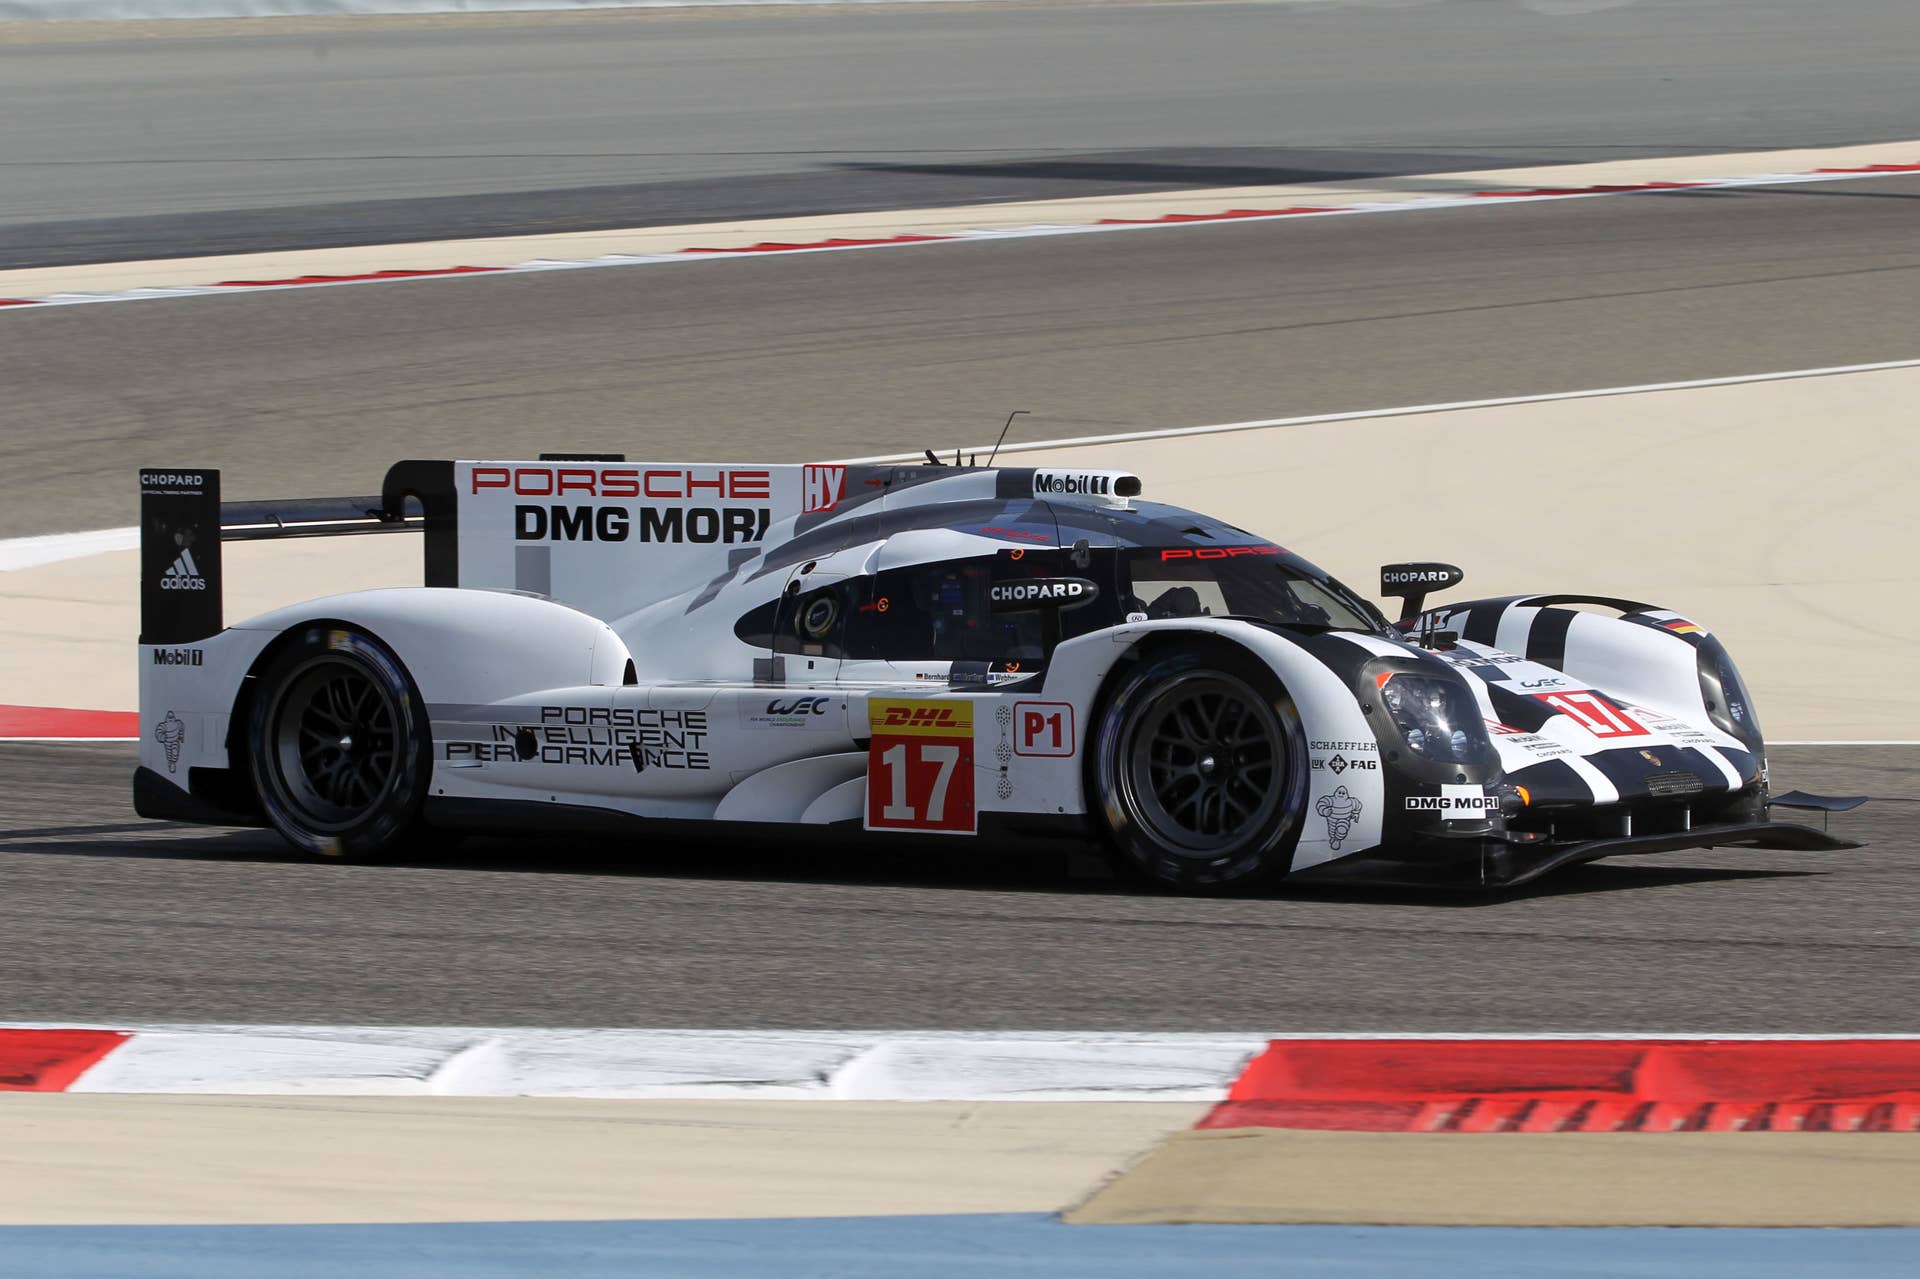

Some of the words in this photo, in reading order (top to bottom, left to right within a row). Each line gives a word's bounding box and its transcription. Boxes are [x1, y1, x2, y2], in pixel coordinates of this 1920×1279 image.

[142, 474, 203, 485] CHOPARD
[471, 468, 770, 498] PORSCHE
[806, 466, 843, 513] HY
[515, 505, 629, 541] DMG
[640, 508, 770, 543] MORI
[160, 575, 206, 590] adidas
[1383, 571, 1449, 582] CHOPARD
[991, 583, 1083, 601] CHOPARD
[1521, 679, 1566, 688] WEC
[766, 697, 829, 715] WEC
[1545, 692, 1635, 734] 17
[541, 706, 707, 729] PORSCHE
[884, 707, 957, 728] DHL
[1025, 712, 1062, 748] P1
[1310, 741, 1377, 752] SCHAEFFLER
[1351, 761, 1377, 770] FAG
[883, 744, 960, 822] 17
[1407, 798, 1451, 809] DMG
[1455, 798, 1499, 809] MORI
